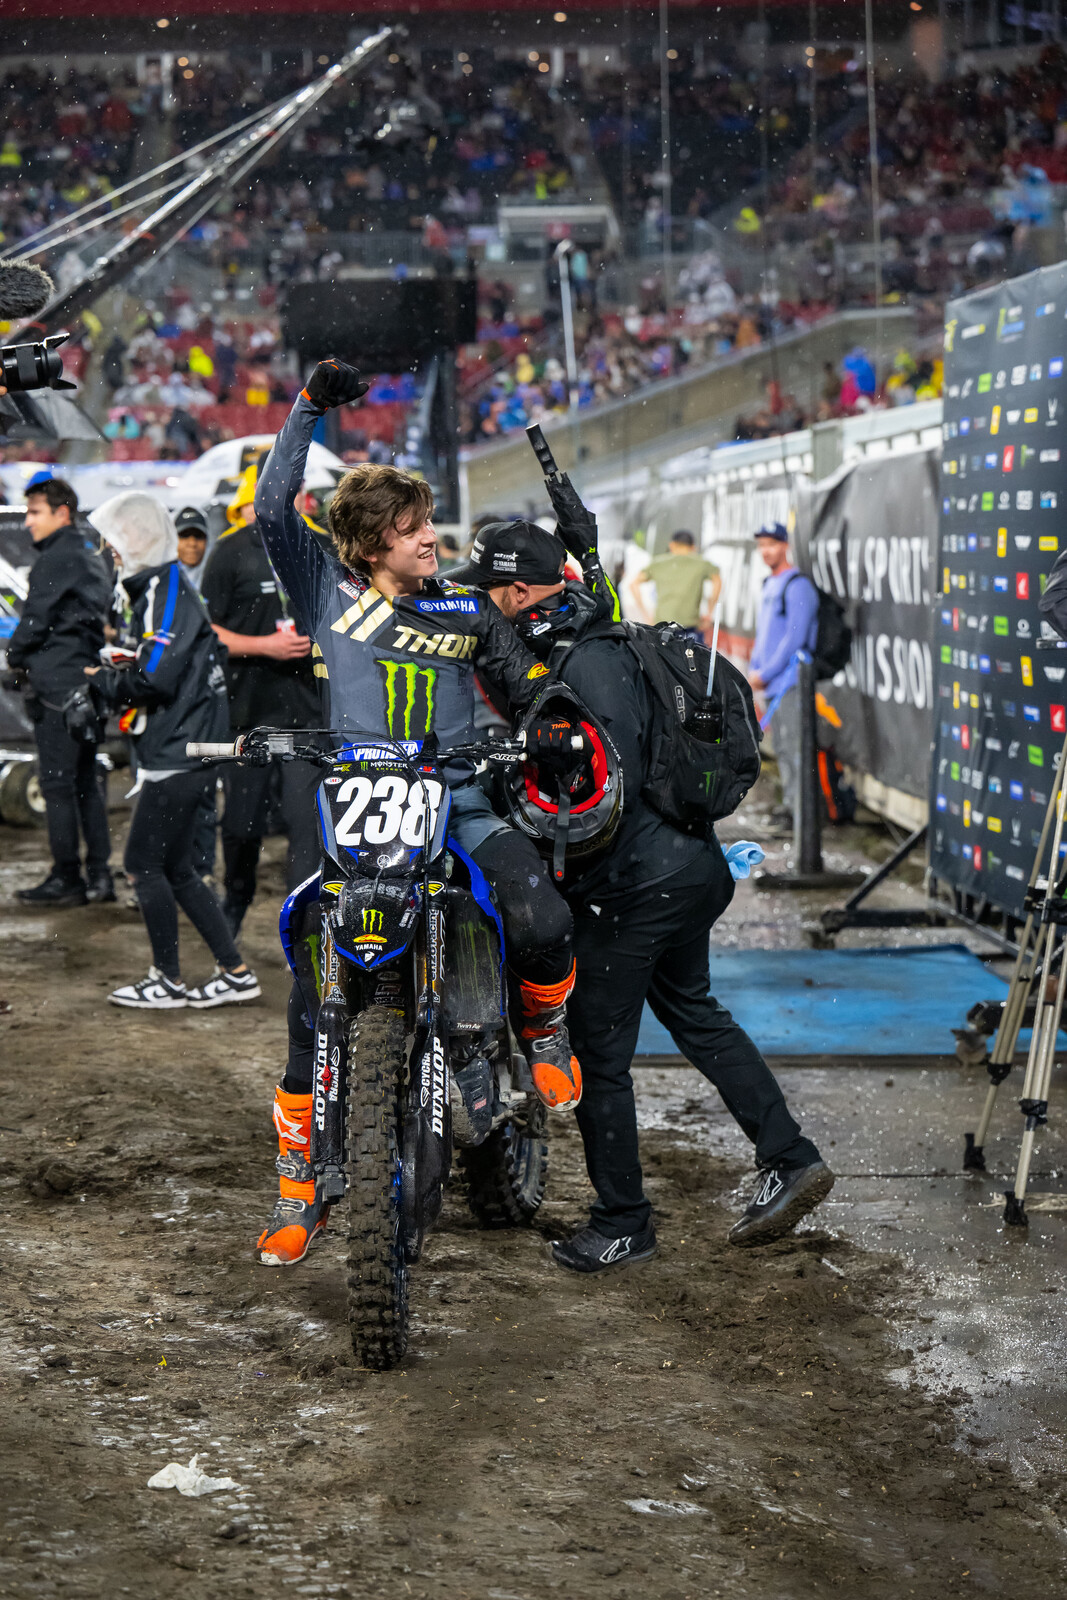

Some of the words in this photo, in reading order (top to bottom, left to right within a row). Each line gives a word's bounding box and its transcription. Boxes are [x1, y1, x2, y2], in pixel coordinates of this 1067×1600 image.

[392, 625, 478, 660] THOR
[552, 721, 571, 729] THOR
[371, 761, 408, 769] MONSTER
[334, 776, 443, 847] 238
[355, 943, 383, 951] YAMAHA
[315, 1031, 328, 1132] DUNLOP
[328, 1066, 339, 1102] CYCRA
[421, 1052, 431, 1087] CYCRA
[432, 1036, 444, 1138] DUNLOP
